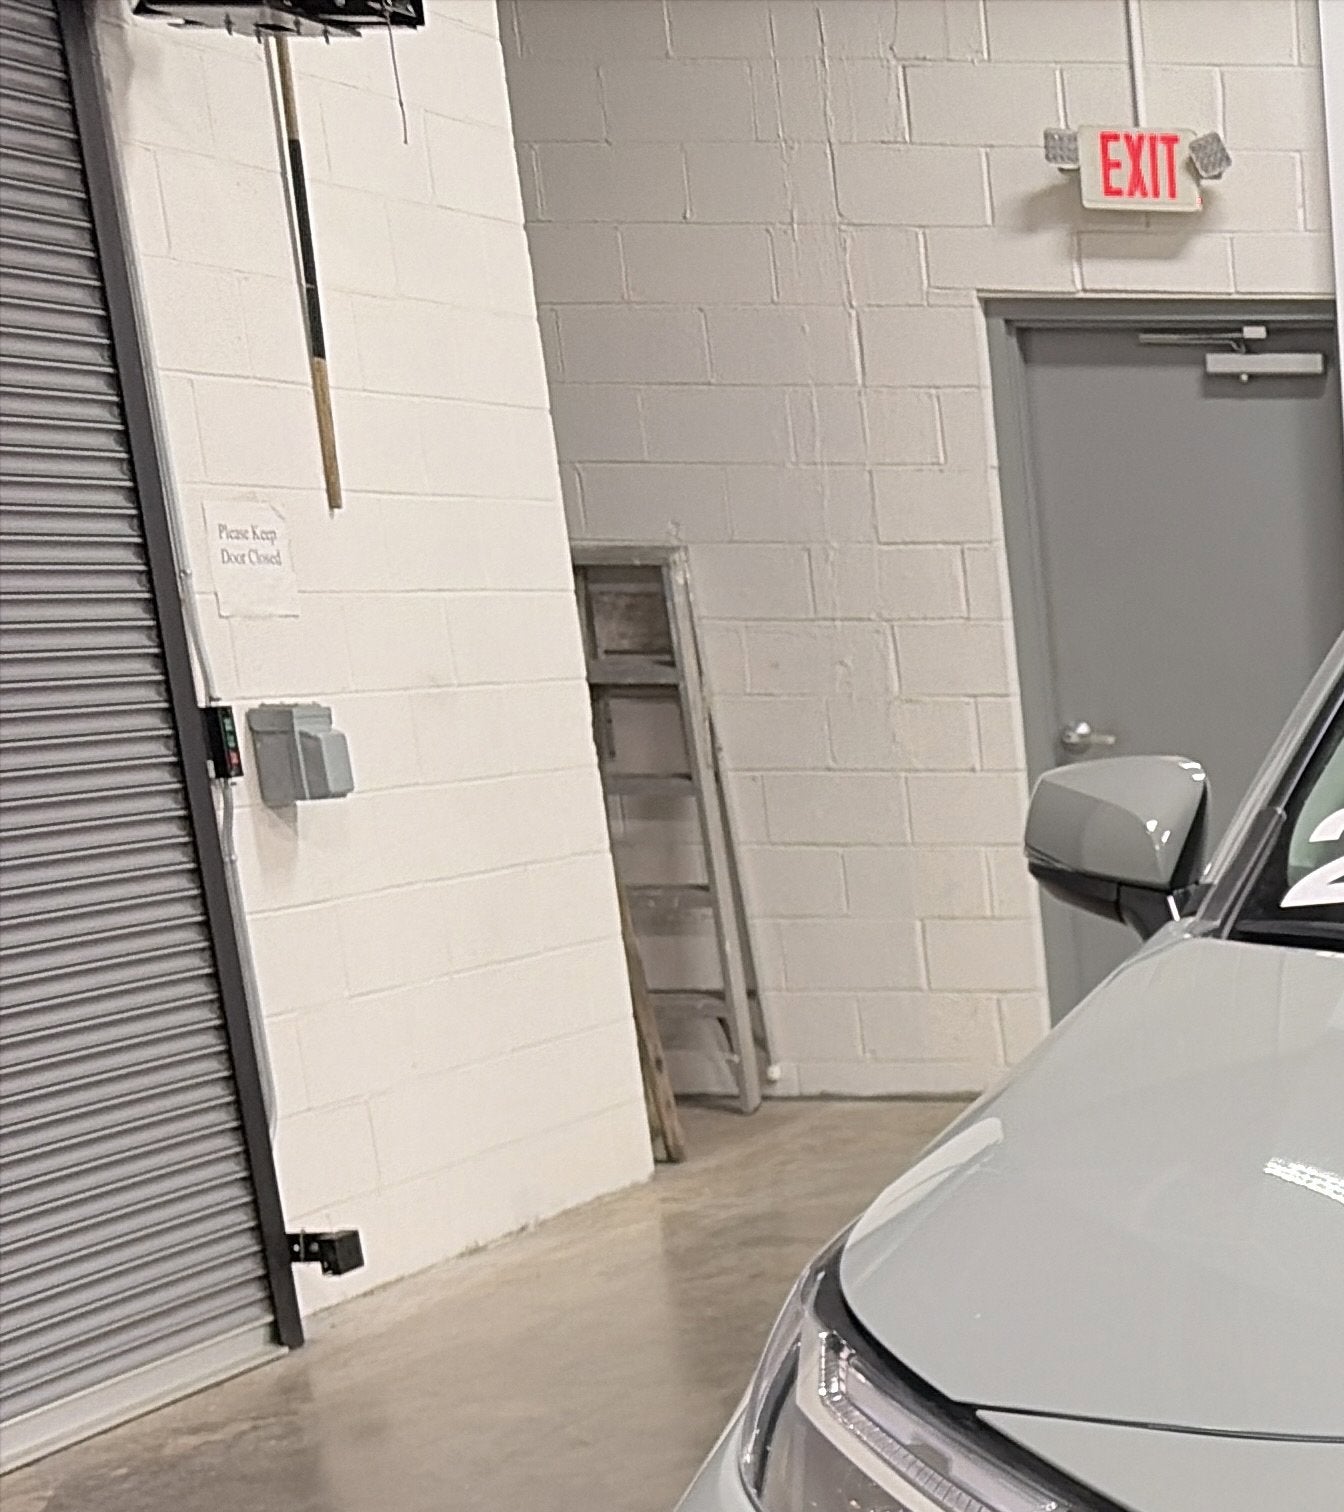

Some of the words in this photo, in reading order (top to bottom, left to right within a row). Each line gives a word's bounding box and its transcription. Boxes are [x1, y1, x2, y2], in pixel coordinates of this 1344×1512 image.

[1100, 131, 1180, 200] EXIT
[218, 523, 249, 540] Please
[251, 524, 277, 545] Keep
[221, 548, 246, 564] Door
[248, 548, 281, 566] Closed
